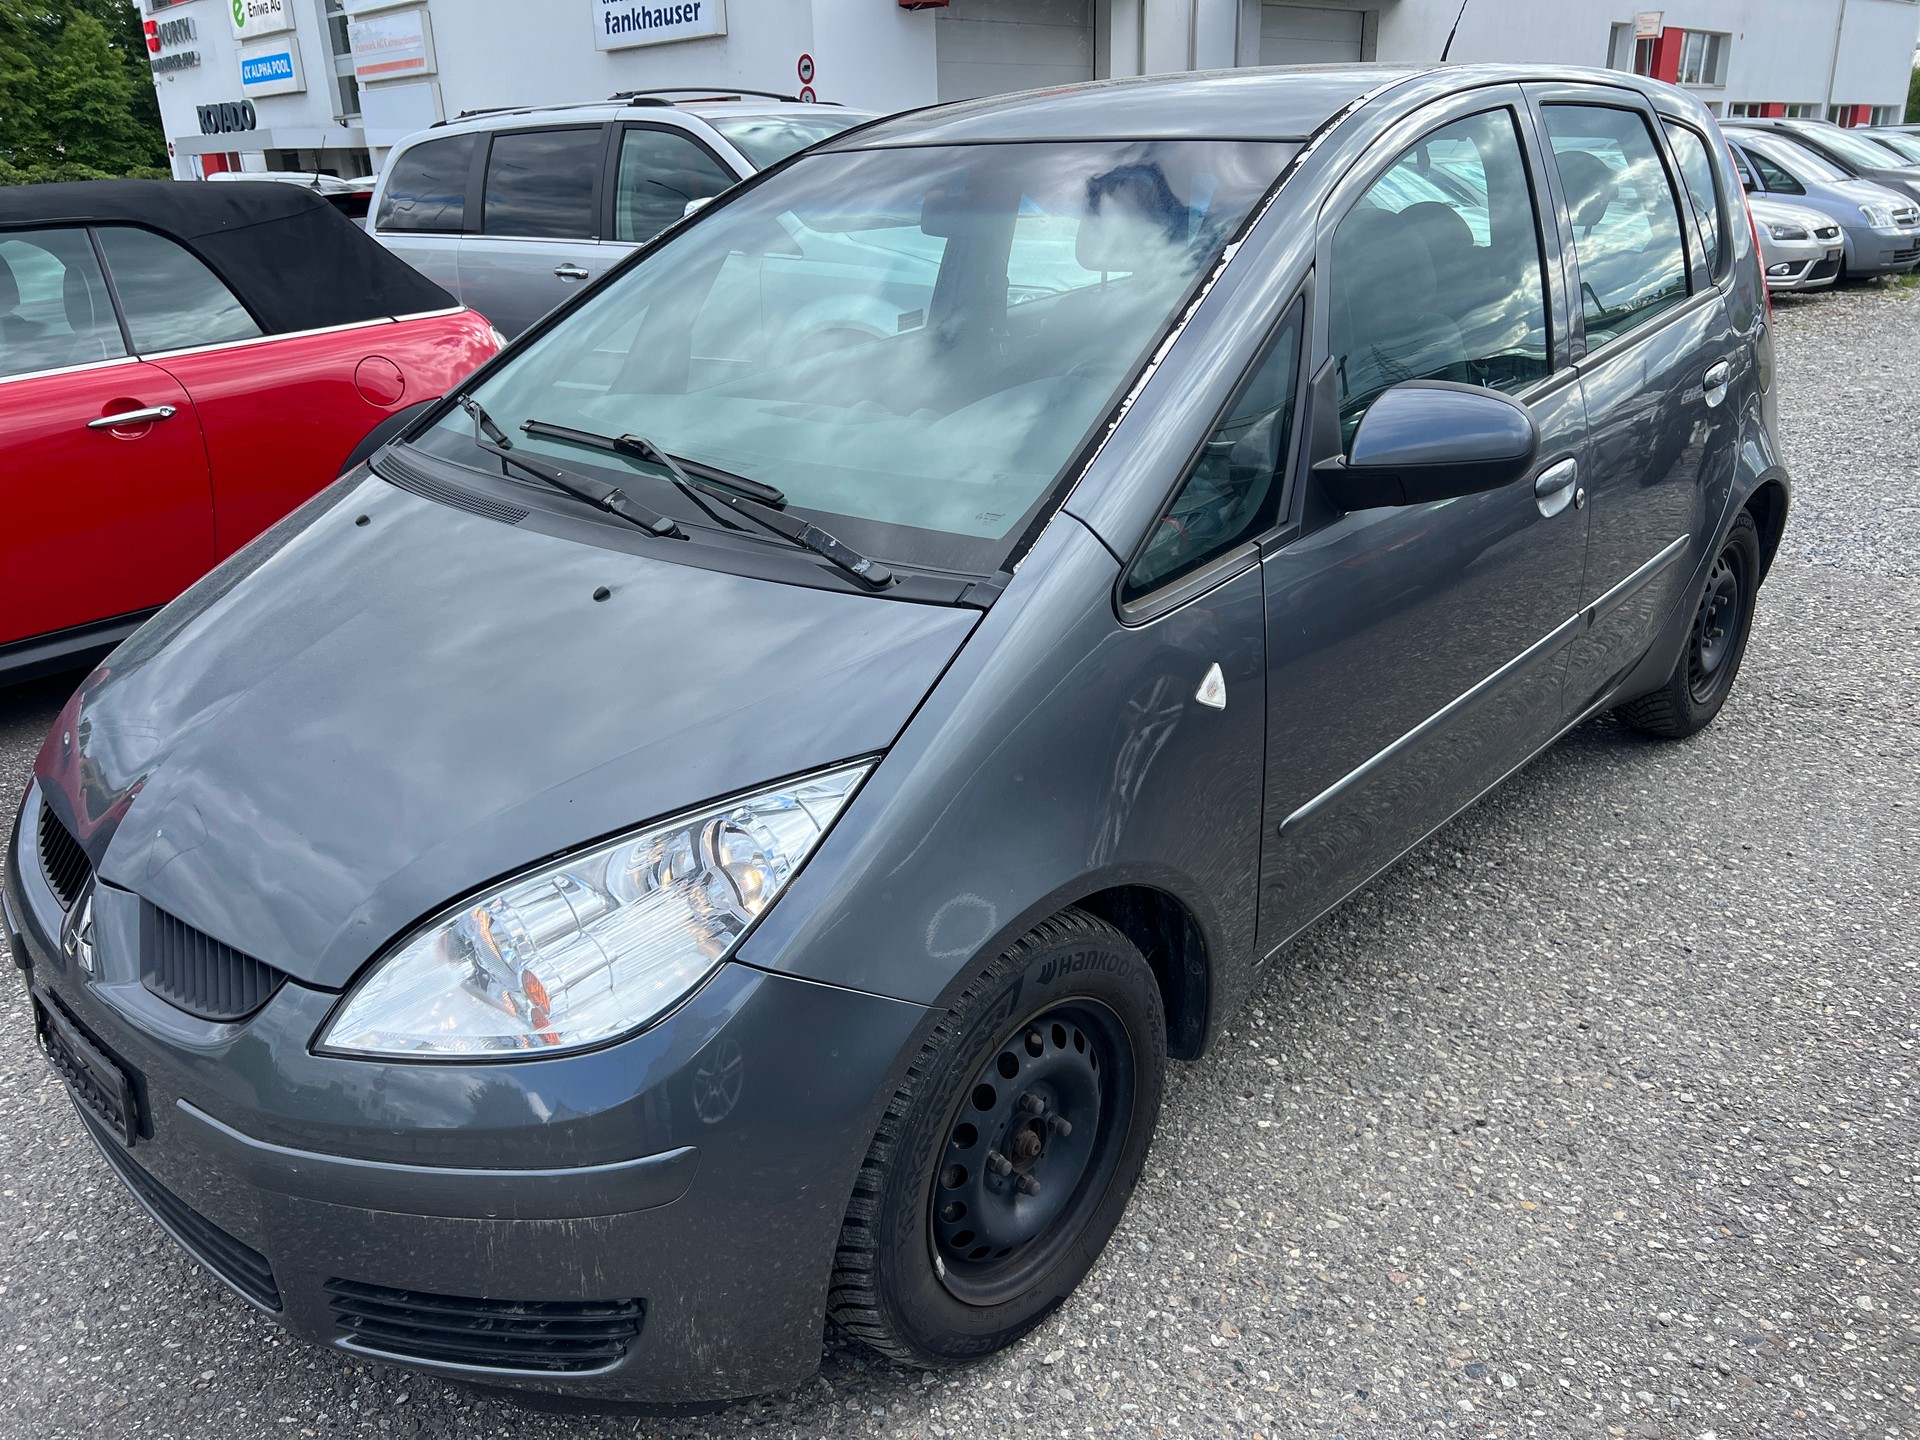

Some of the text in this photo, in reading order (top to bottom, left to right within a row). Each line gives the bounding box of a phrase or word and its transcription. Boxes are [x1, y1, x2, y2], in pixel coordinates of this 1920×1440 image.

[247, 0, 282, 17] Eniwa AG
[604, 2, 701, 35] fankhauser
[251, 59, 291, 79] ALPHA POOL
[196, 99, 257, 135] ROVADO
